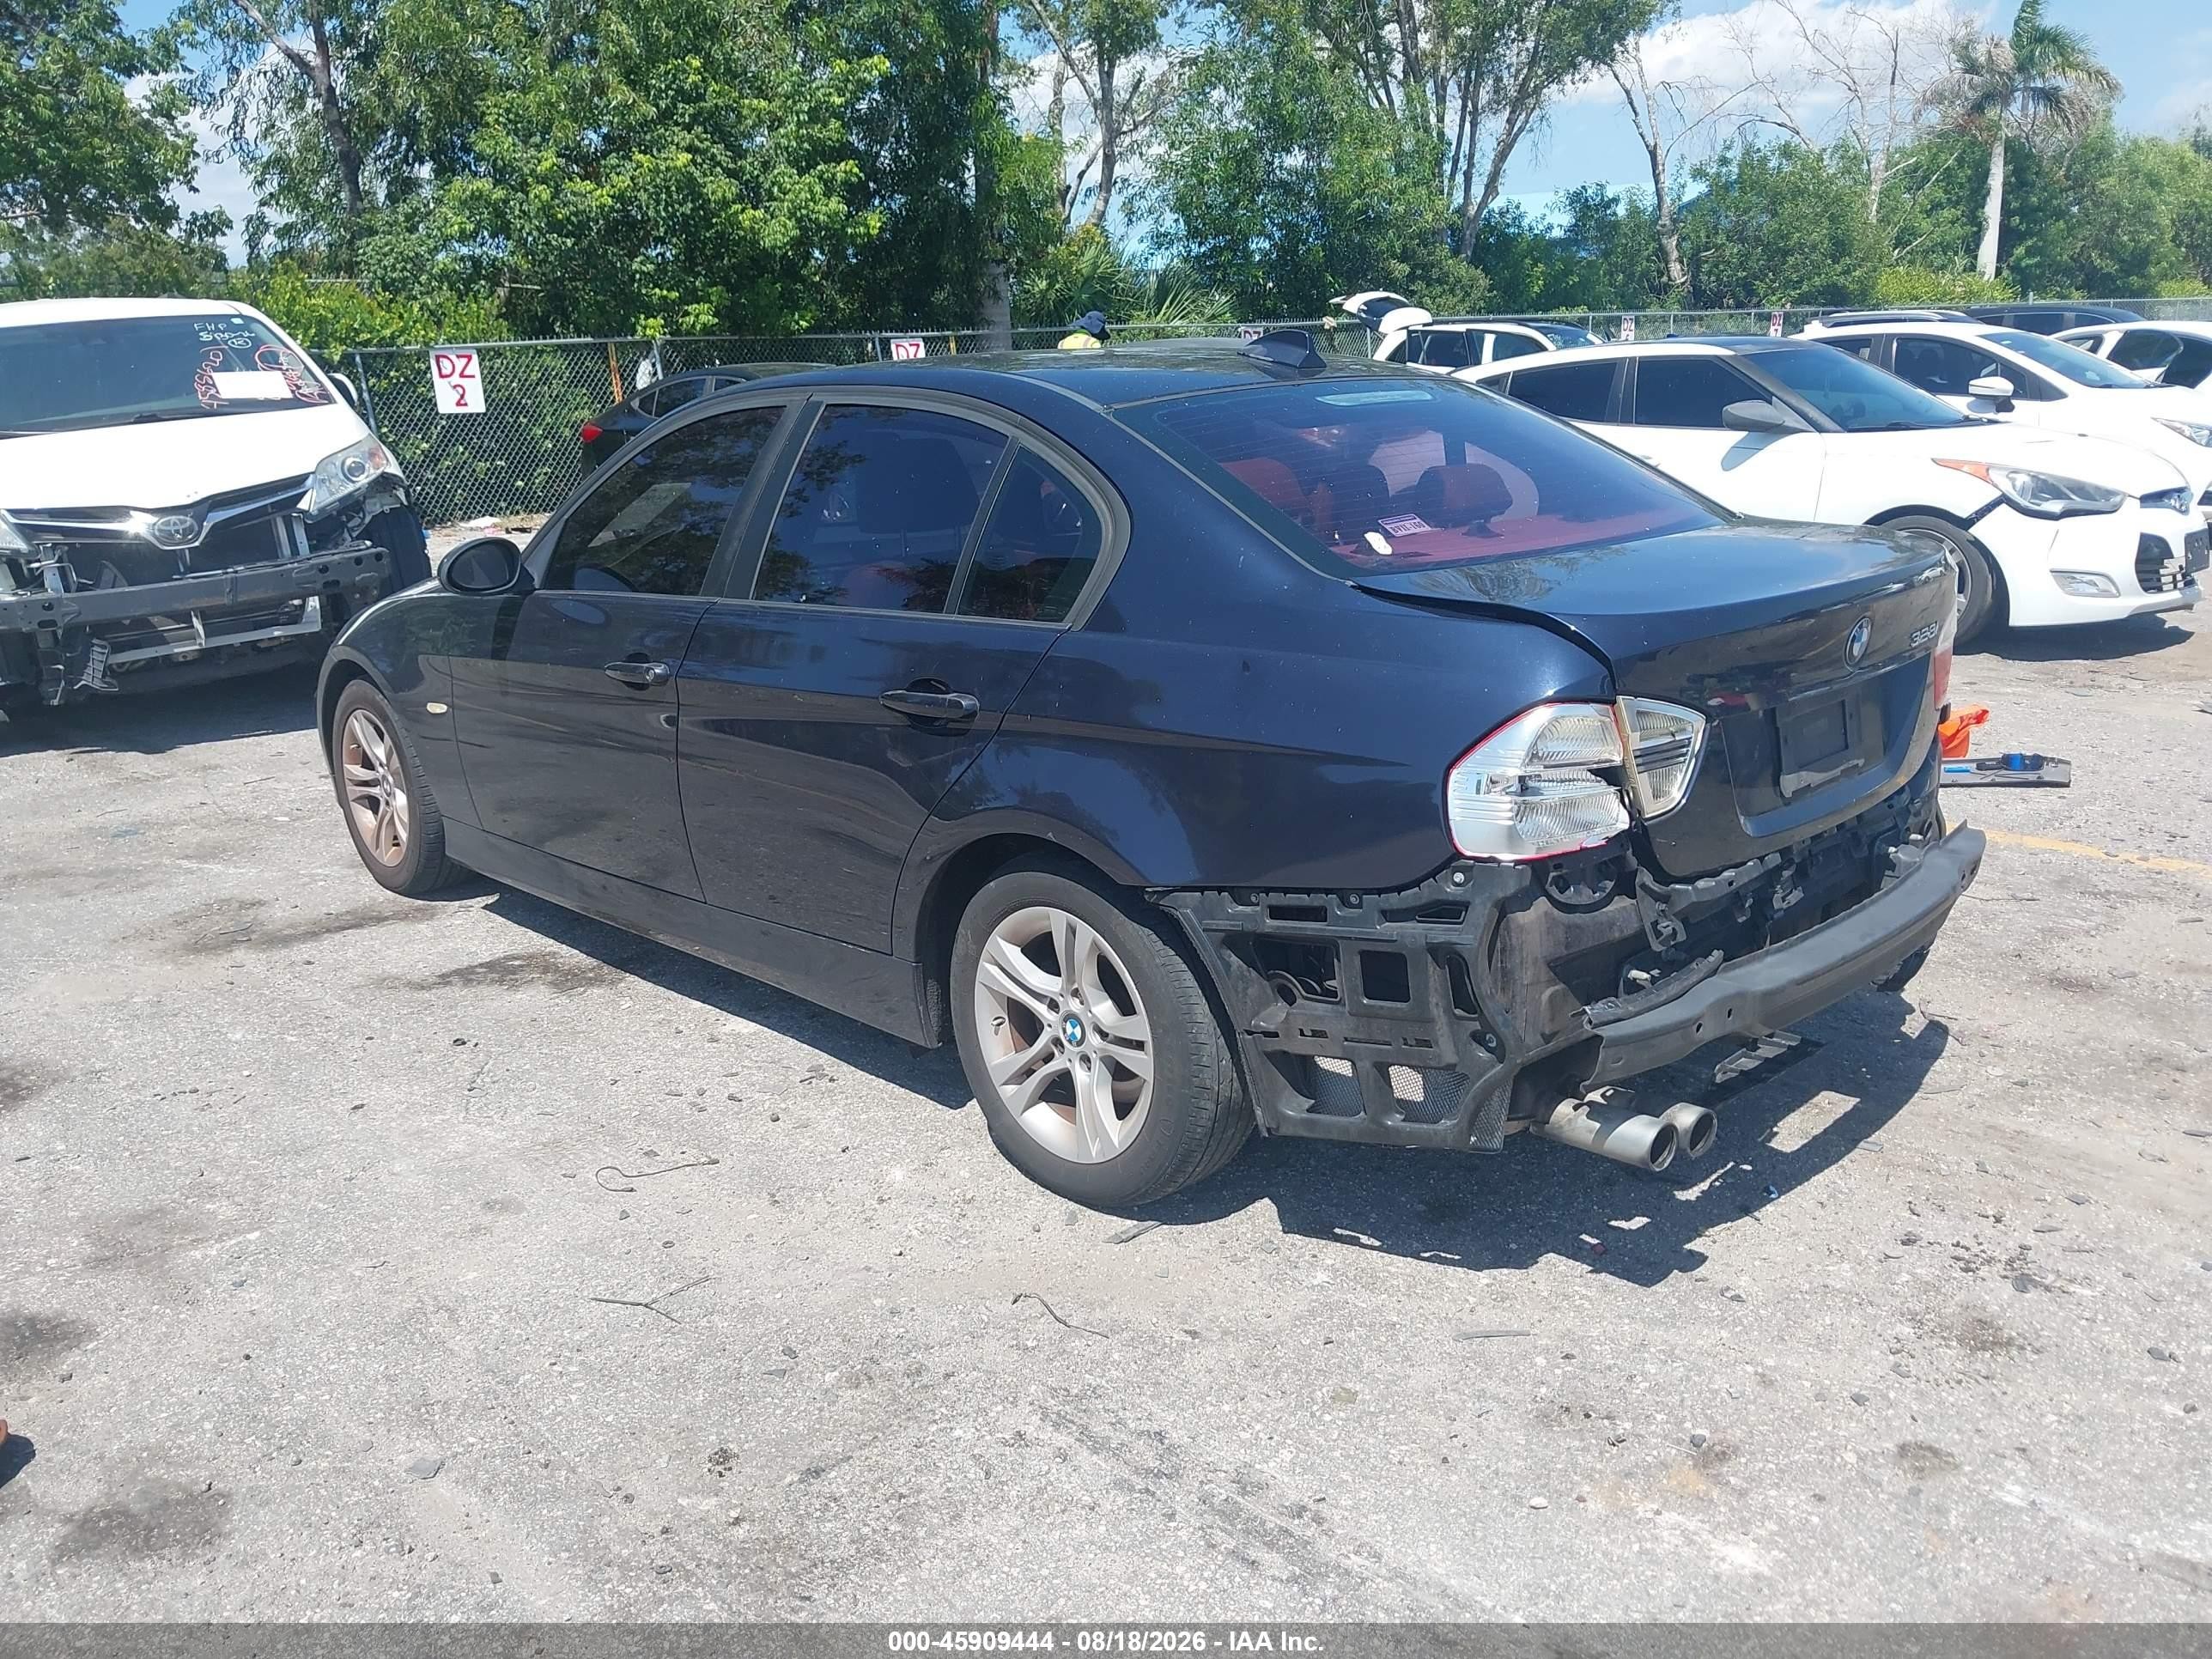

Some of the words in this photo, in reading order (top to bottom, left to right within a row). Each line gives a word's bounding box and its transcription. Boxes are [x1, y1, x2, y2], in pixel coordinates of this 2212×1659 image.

[1623, 318, 1634, 332] DZ
[1771, 313, 1783, 326] DZ
[434, 354, 476, 379] DZ
[453, 384, 468, 407] 2
